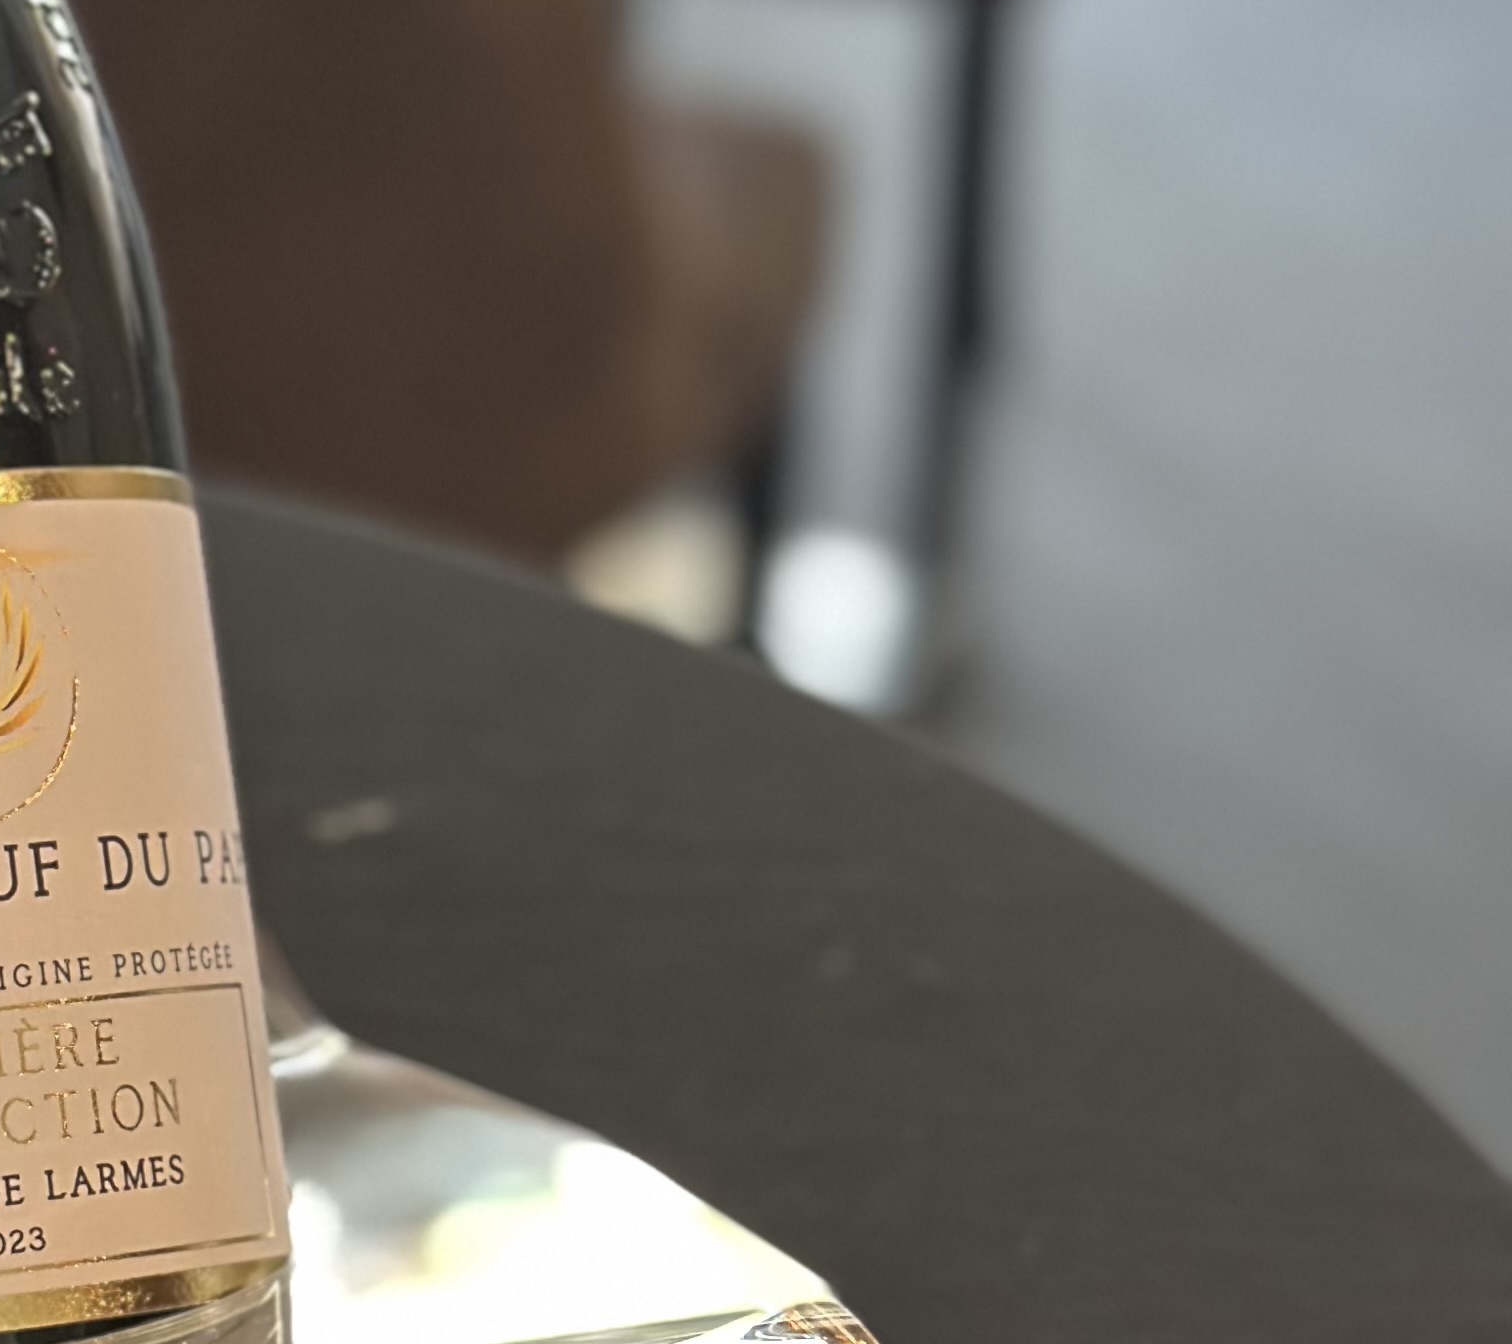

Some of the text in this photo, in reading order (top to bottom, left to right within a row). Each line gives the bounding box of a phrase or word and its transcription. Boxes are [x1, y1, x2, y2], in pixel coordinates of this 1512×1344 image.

[97, 831, 171, 891] DU
[193, 829, 245, 885] PA
[112, 940, 234, 978] PROTÉGÉE
[43, 1154, 186, 1201] LARMES
